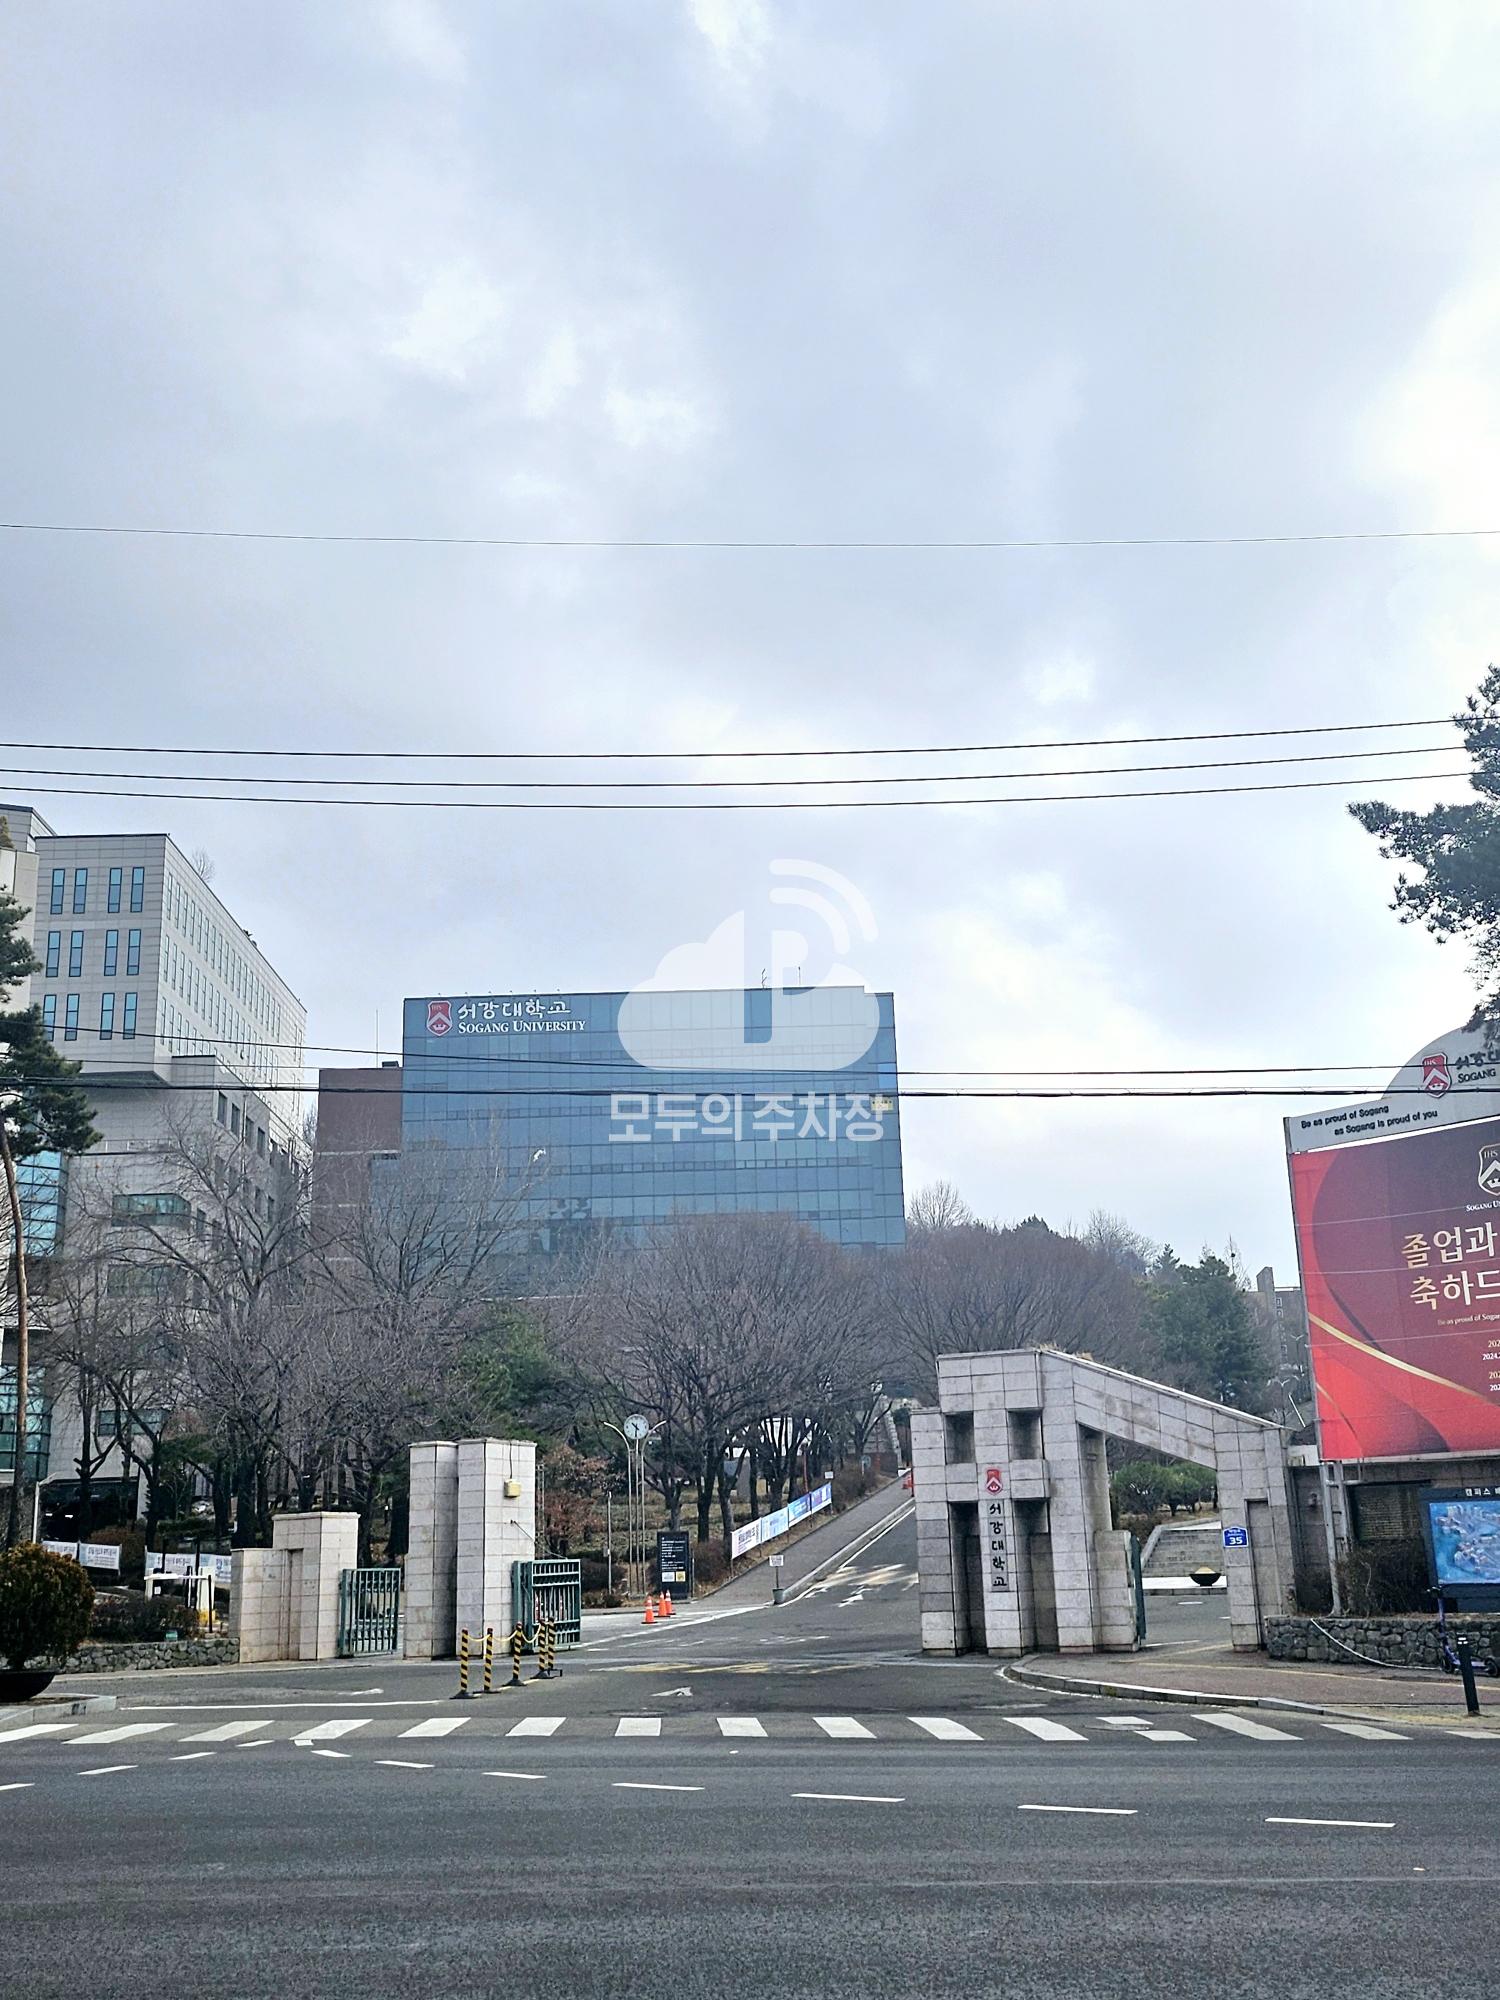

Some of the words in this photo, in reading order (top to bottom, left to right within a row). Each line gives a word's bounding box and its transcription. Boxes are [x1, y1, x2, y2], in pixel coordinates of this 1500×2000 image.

[458, 998, 571, 1020] 서강대학교
[458, 1021, 509, 1034] SOGANG
[513, 1020, 586, 1032] UNIVERSITY
[1457, 1068, 1497, 1083] SOGANG
[1301, 1120, 1312, 1129] Be
[1313, 1118, 1322, 1126] as
[1325, 1114, 1347, 1126] proud
[1349, 1111, 1357, 1119] of
[1359, 1105, 1389, 1117] Sogang
[1334, 1128, 1344, 1136] as
[1346, 1121, 1375, 1134] Sogang
[1387, 1115, 1411, 1127] proud
[1412, 1111, 1421, 1120] of
[1423, 1110, 1438, 1120] you
[1484, 1150, 1498, 1159] IHS
[1466, 1202, 1492, 1212] SOGANG
[1401, 1222, 1498, 1270] 졸업과
[1410, 1270, 1500, 1310] 축하드
[989, 1503, 1008, 1587] 서강대학교
[1229, 1536, 1243, 1545] 35
